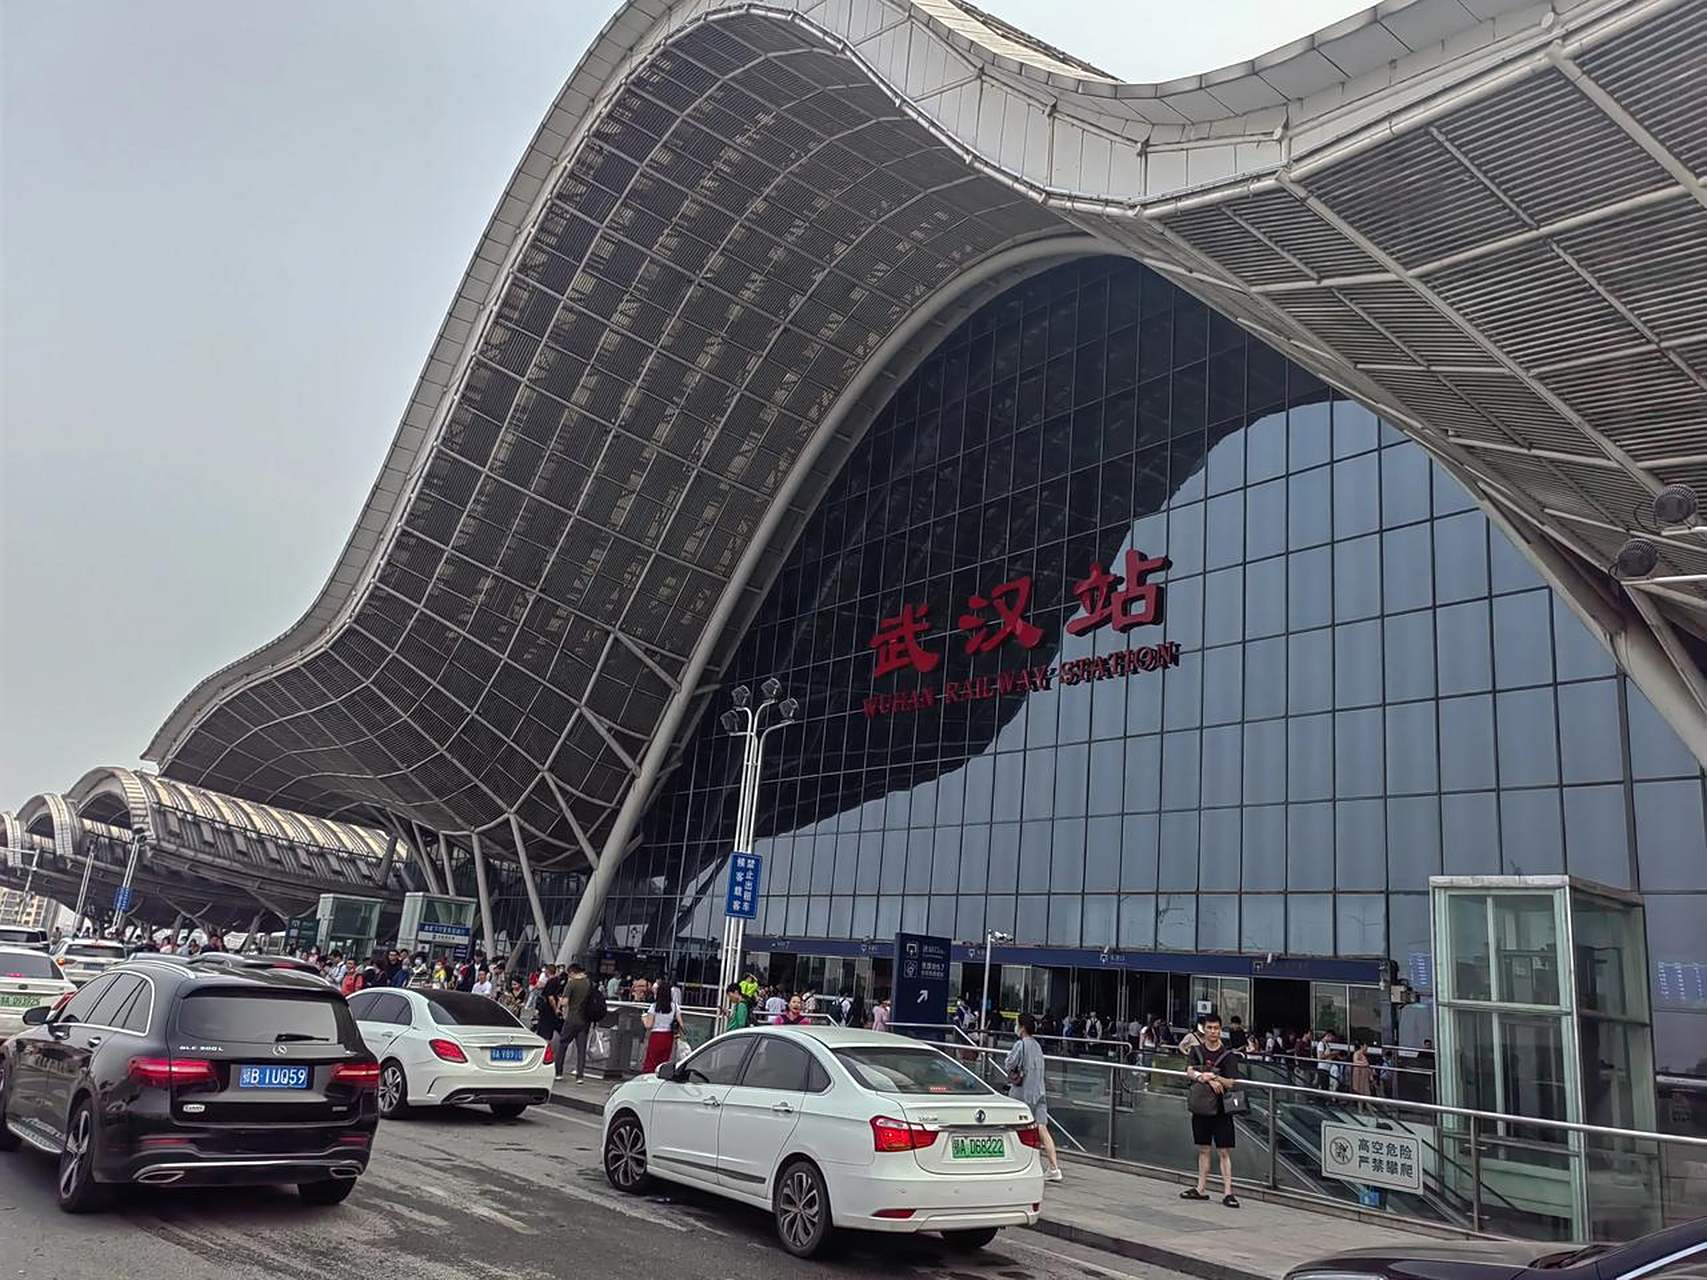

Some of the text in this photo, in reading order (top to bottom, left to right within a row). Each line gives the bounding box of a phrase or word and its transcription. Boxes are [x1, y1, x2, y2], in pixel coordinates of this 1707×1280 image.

[869, 549, 1171, 679] 武汉站
[863, 641, 1180, 718] WUHAN RAILWAY STATION
[1359, 1138, 1412, 1160] 高空危险
[1359, 1155, 1413, 1178] 严禁攀爬
